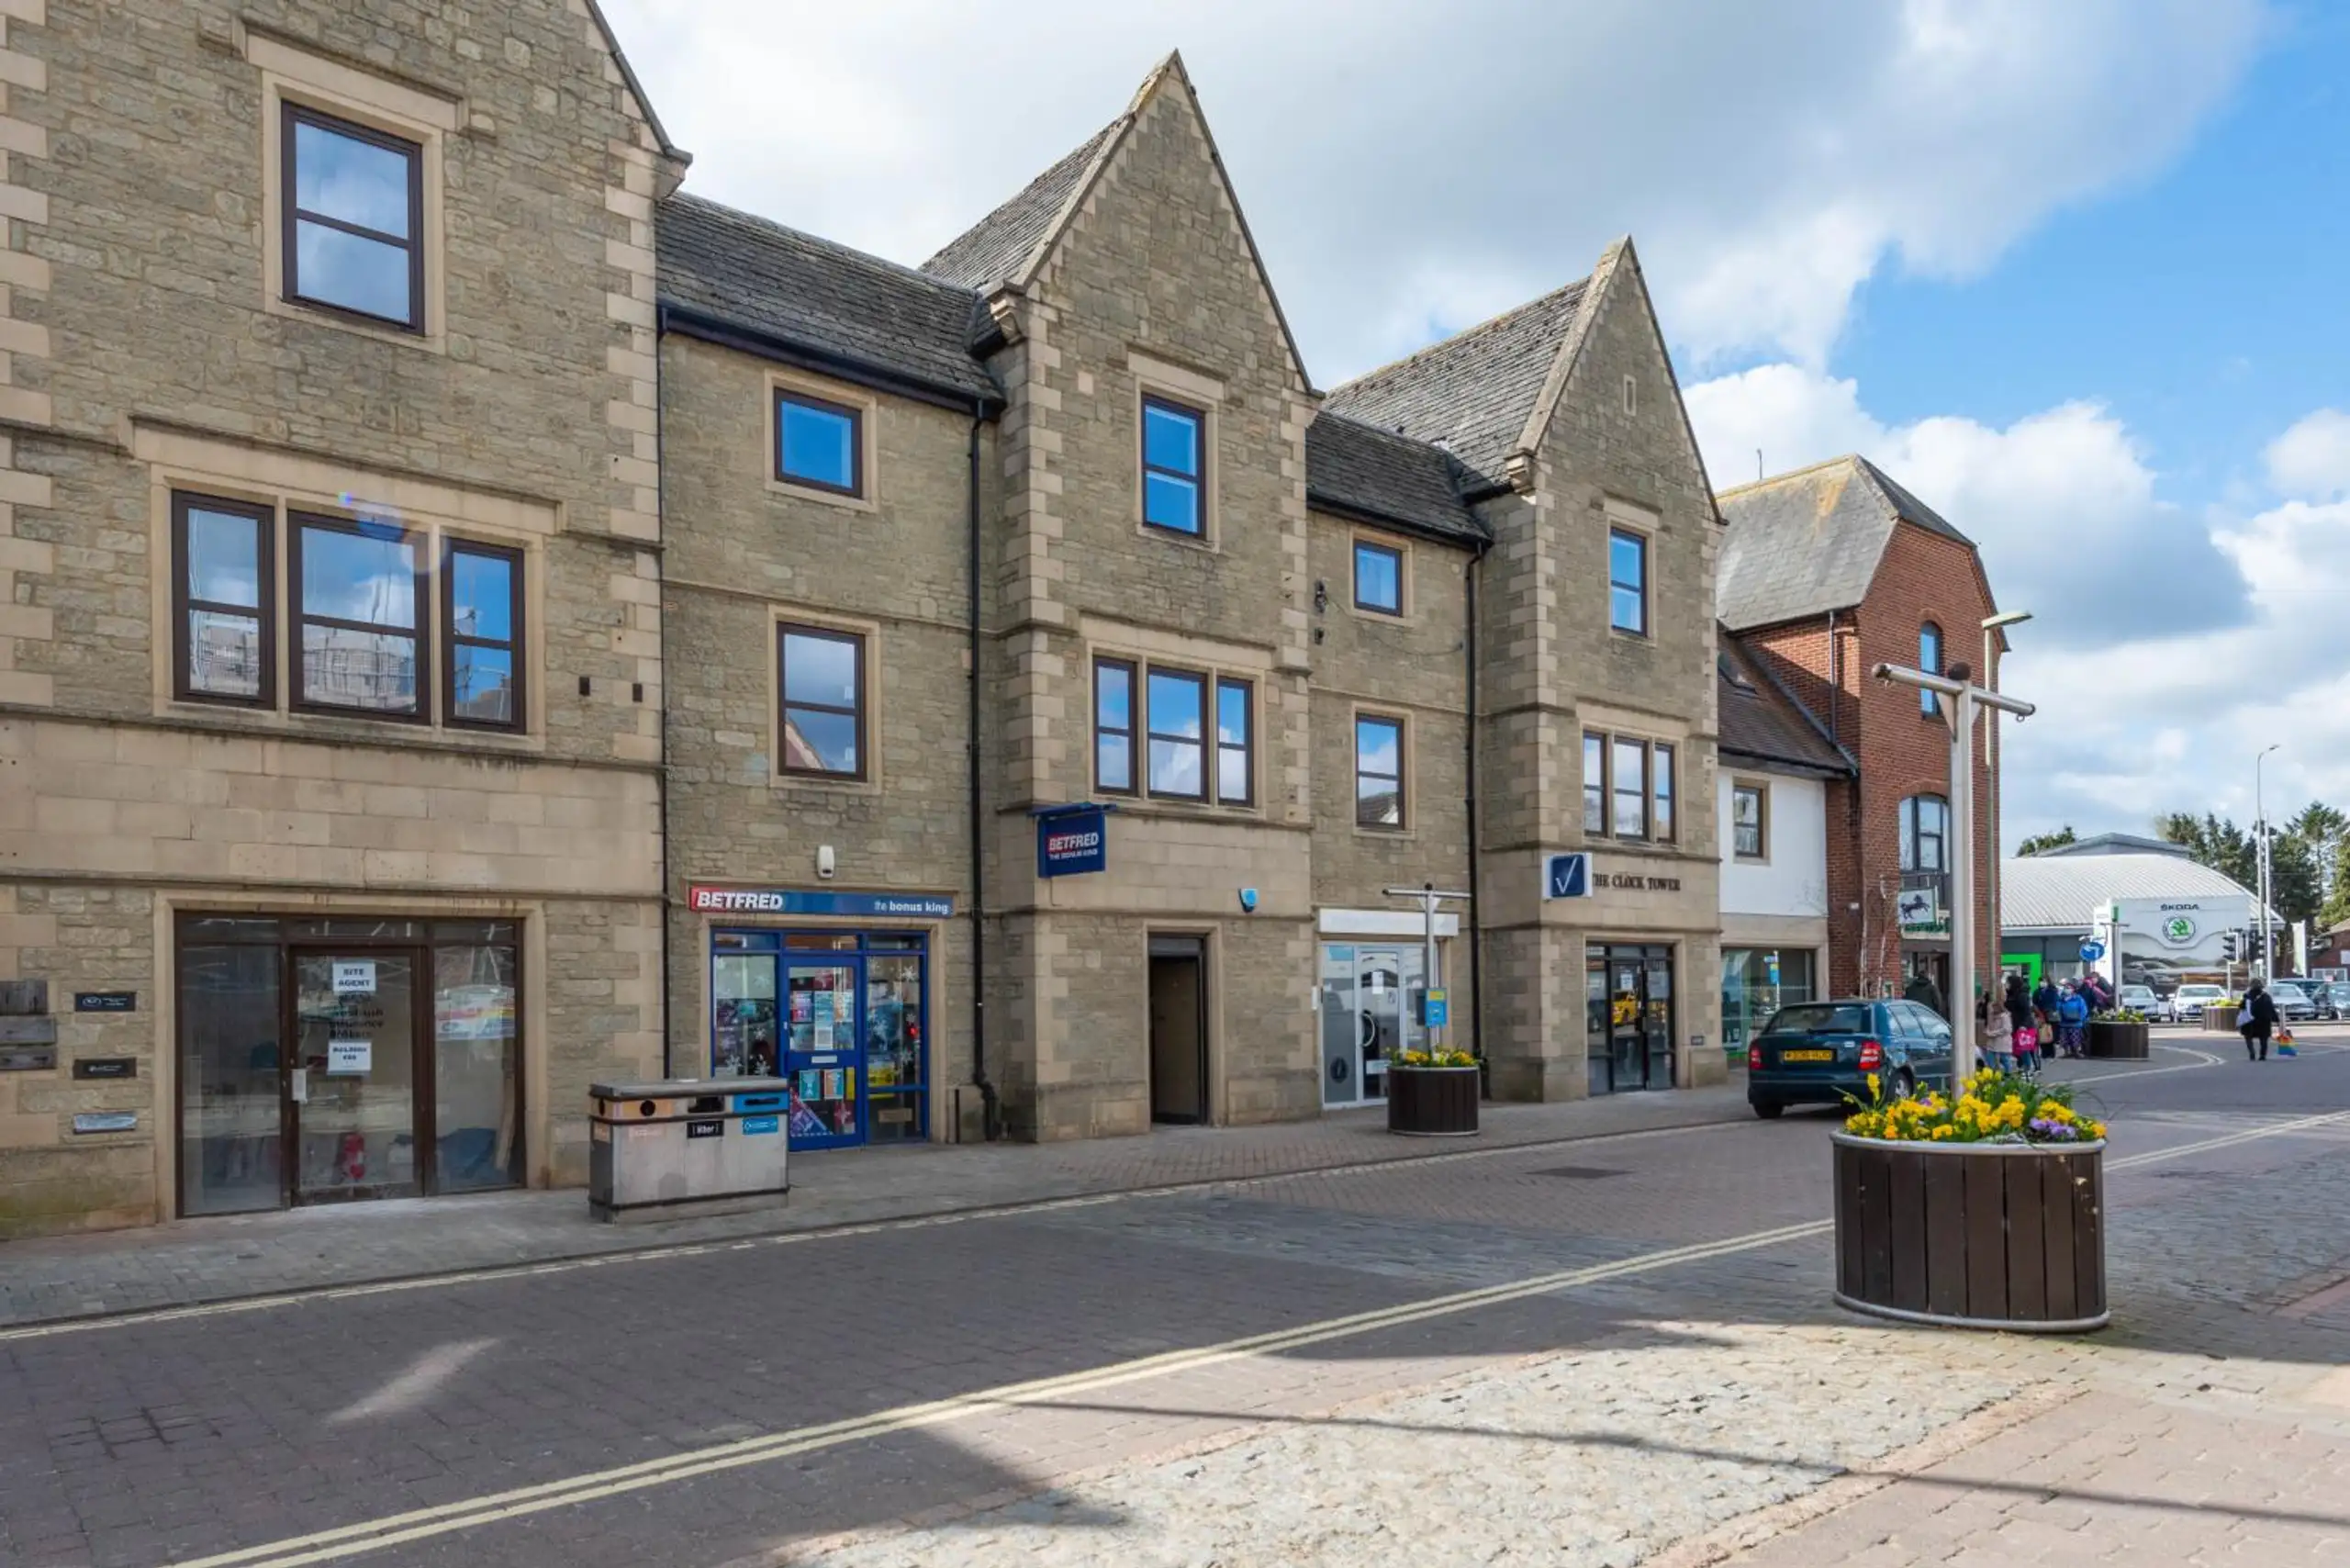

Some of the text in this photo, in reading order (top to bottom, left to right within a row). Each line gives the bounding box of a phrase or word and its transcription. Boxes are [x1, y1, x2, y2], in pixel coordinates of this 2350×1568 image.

[1048, 832, 1100, 851] BETFRED
[1612, 875, 1644, 890] CLOCK
[1648, 878, 1681, 891] TOWER
[697, 890, 784, 911] BETFRED
[890, 899, 922, 912] bonus
[925, 900, 949, 915] king
[338, 979, 371, 988] AGENT
